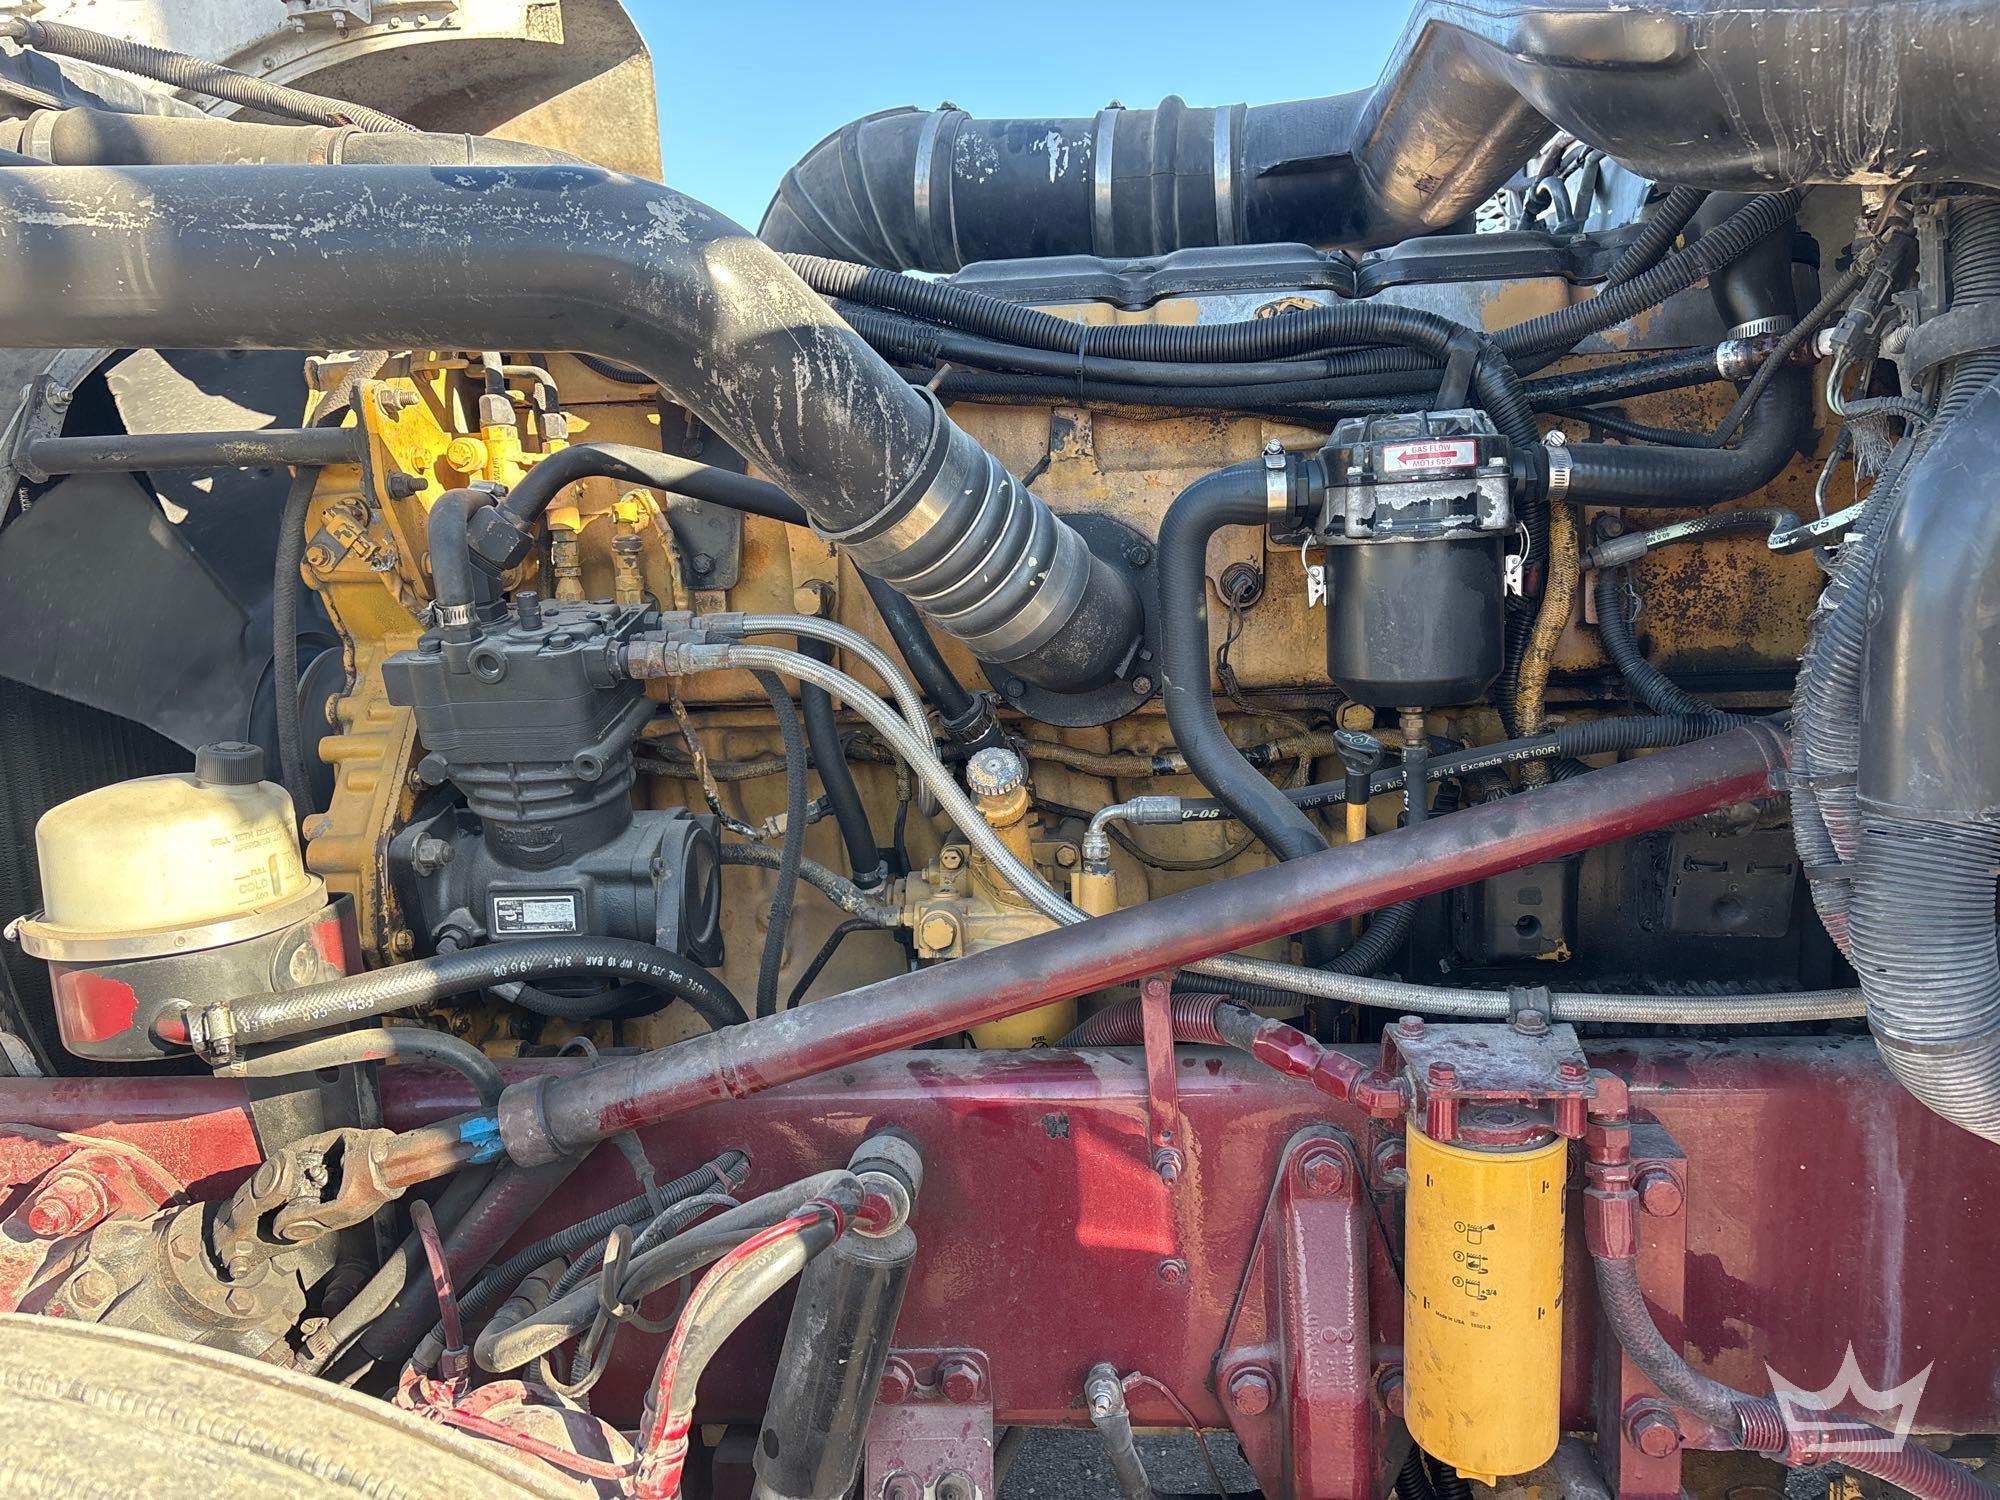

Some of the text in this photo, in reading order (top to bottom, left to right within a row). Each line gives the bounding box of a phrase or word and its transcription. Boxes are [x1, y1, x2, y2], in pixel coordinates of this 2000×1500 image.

[1412, 444, 1451, 453] GAS FLOW
[1412, 459, 1434, 467] FLOW
[1460, 757, 1503, 773] Exceeds
[1181, 808, 1220, 819] 0-06
[239, 878, 268, 894] COLD
[586, 956, 604, 966] BAR
[620, 959, 633, 969] WP
[668, 970, 683, 984] SAE
[1481, 1288, 1498, 1297] +3/4
[1453, 1316, 1465, 1325] USA
